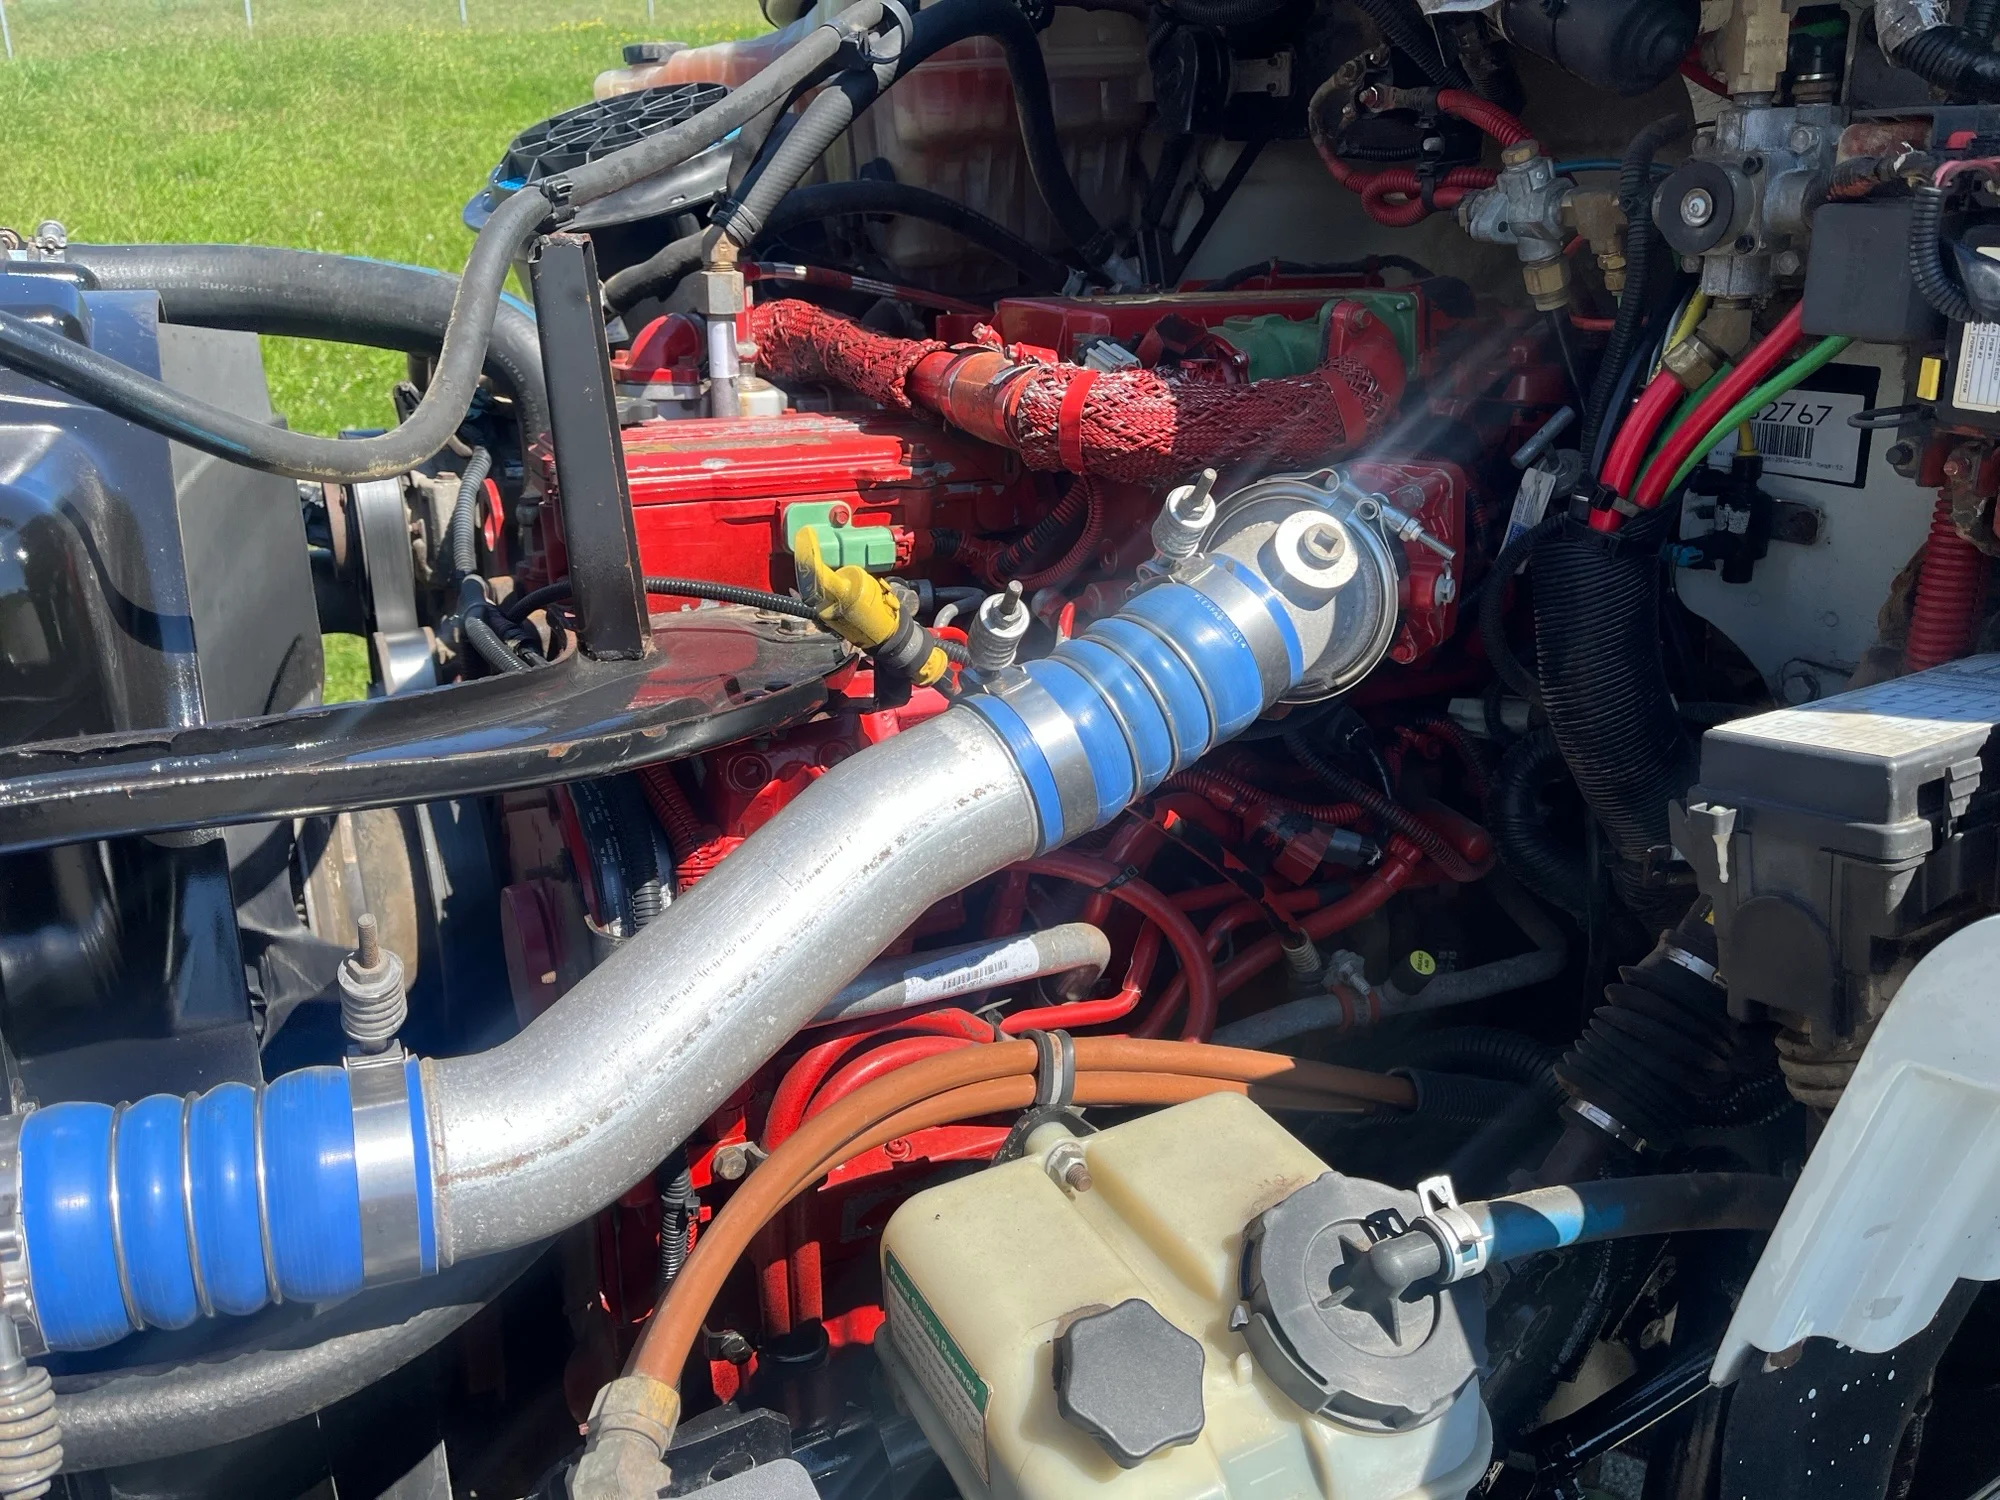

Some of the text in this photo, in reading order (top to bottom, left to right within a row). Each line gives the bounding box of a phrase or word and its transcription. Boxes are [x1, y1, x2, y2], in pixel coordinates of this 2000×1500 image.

[1964, 360, 1972, 379] TRAIN
[1193, 594, 1224, 620] FLEXFAB
[890, 1265, 977, 1397] Power Steering Reservoir
